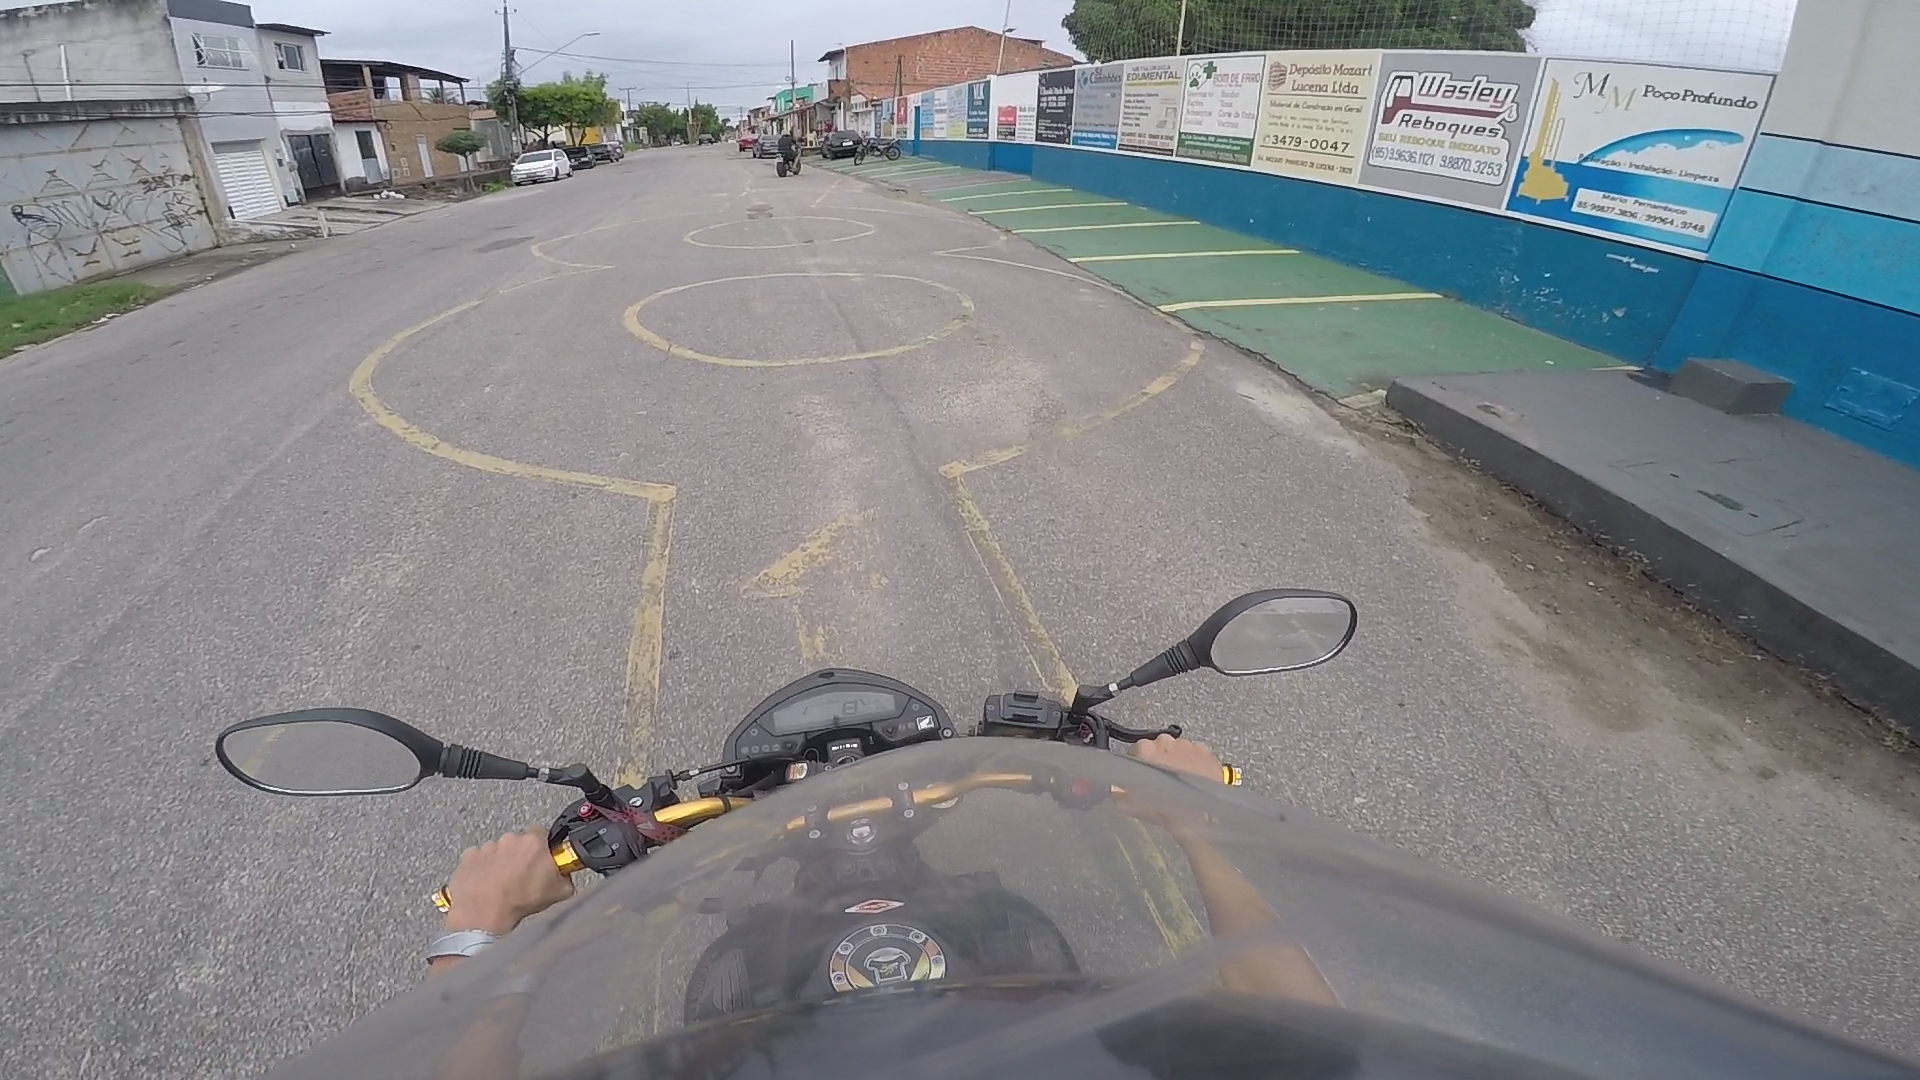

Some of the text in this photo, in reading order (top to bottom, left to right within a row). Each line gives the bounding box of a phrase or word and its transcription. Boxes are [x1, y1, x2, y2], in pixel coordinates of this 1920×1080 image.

[1127, 71, 1181, 81] EDUMENTAL
[1288, 63, 1373, 77] Depósito Mozart
[1291, 79, 1359, 94] Lucena Ltda
[1418, 75, 1512, 109] Wasley
[1642, 84, 1681, 100] Poço
[1681, 89, 1759, 110] Profundo
[1398, 113, 1501, 139] Reboques
[1271, 134, 1350, 152] 3479-0047
[1678, 168, 1720, 182] Limpeza
